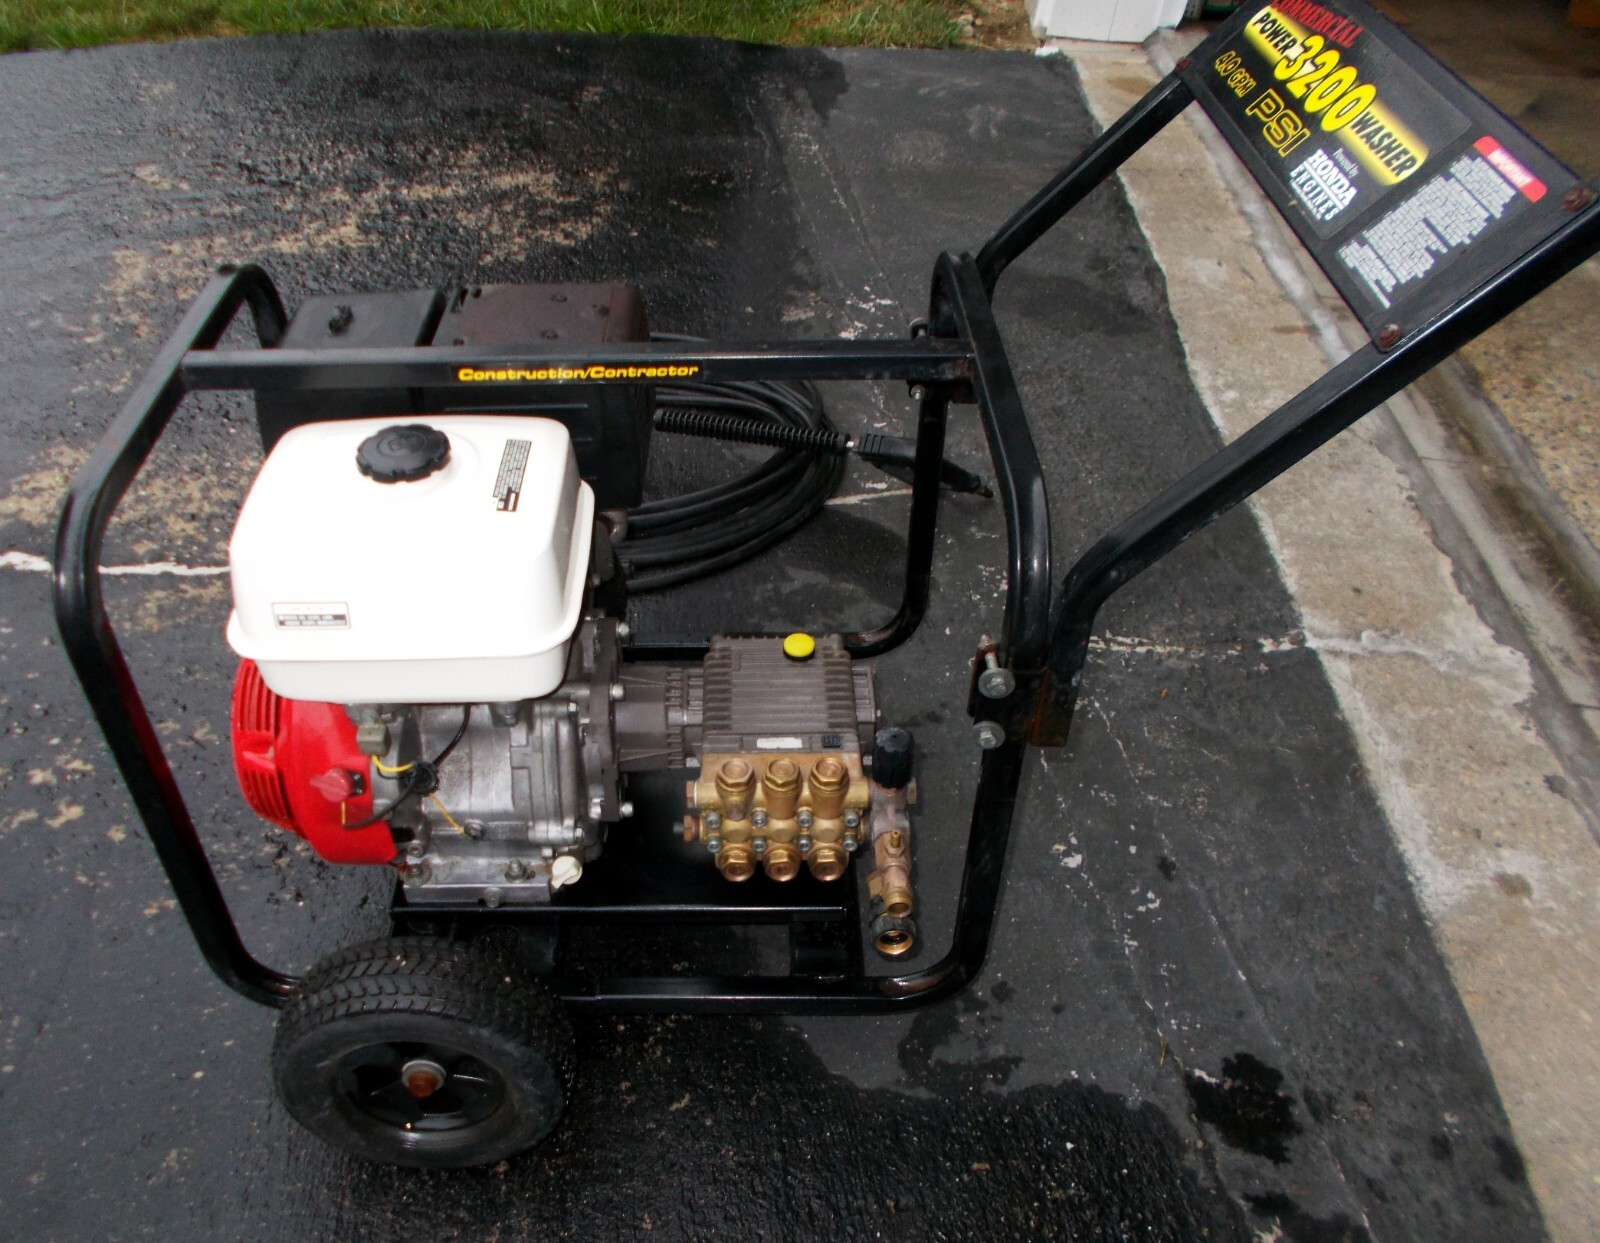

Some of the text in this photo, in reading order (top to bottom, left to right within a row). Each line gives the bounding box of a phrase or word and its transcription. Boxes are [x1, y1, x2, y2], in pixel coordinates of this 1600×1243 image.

[1253, 11, 1299, 55] POWER
[1227, 68, 1257, 98] GPM
[1273, 34, 1377, 132] 3200
[1245, 87, 1312, 158] PSI
[1350, 110, 1418, 178] WASHER
[1289, 164, 1340, 220] ENGINES
[1307, 148, 1358, 206] HONDA
[458, 366, 699, 381] Construction/Contractor
